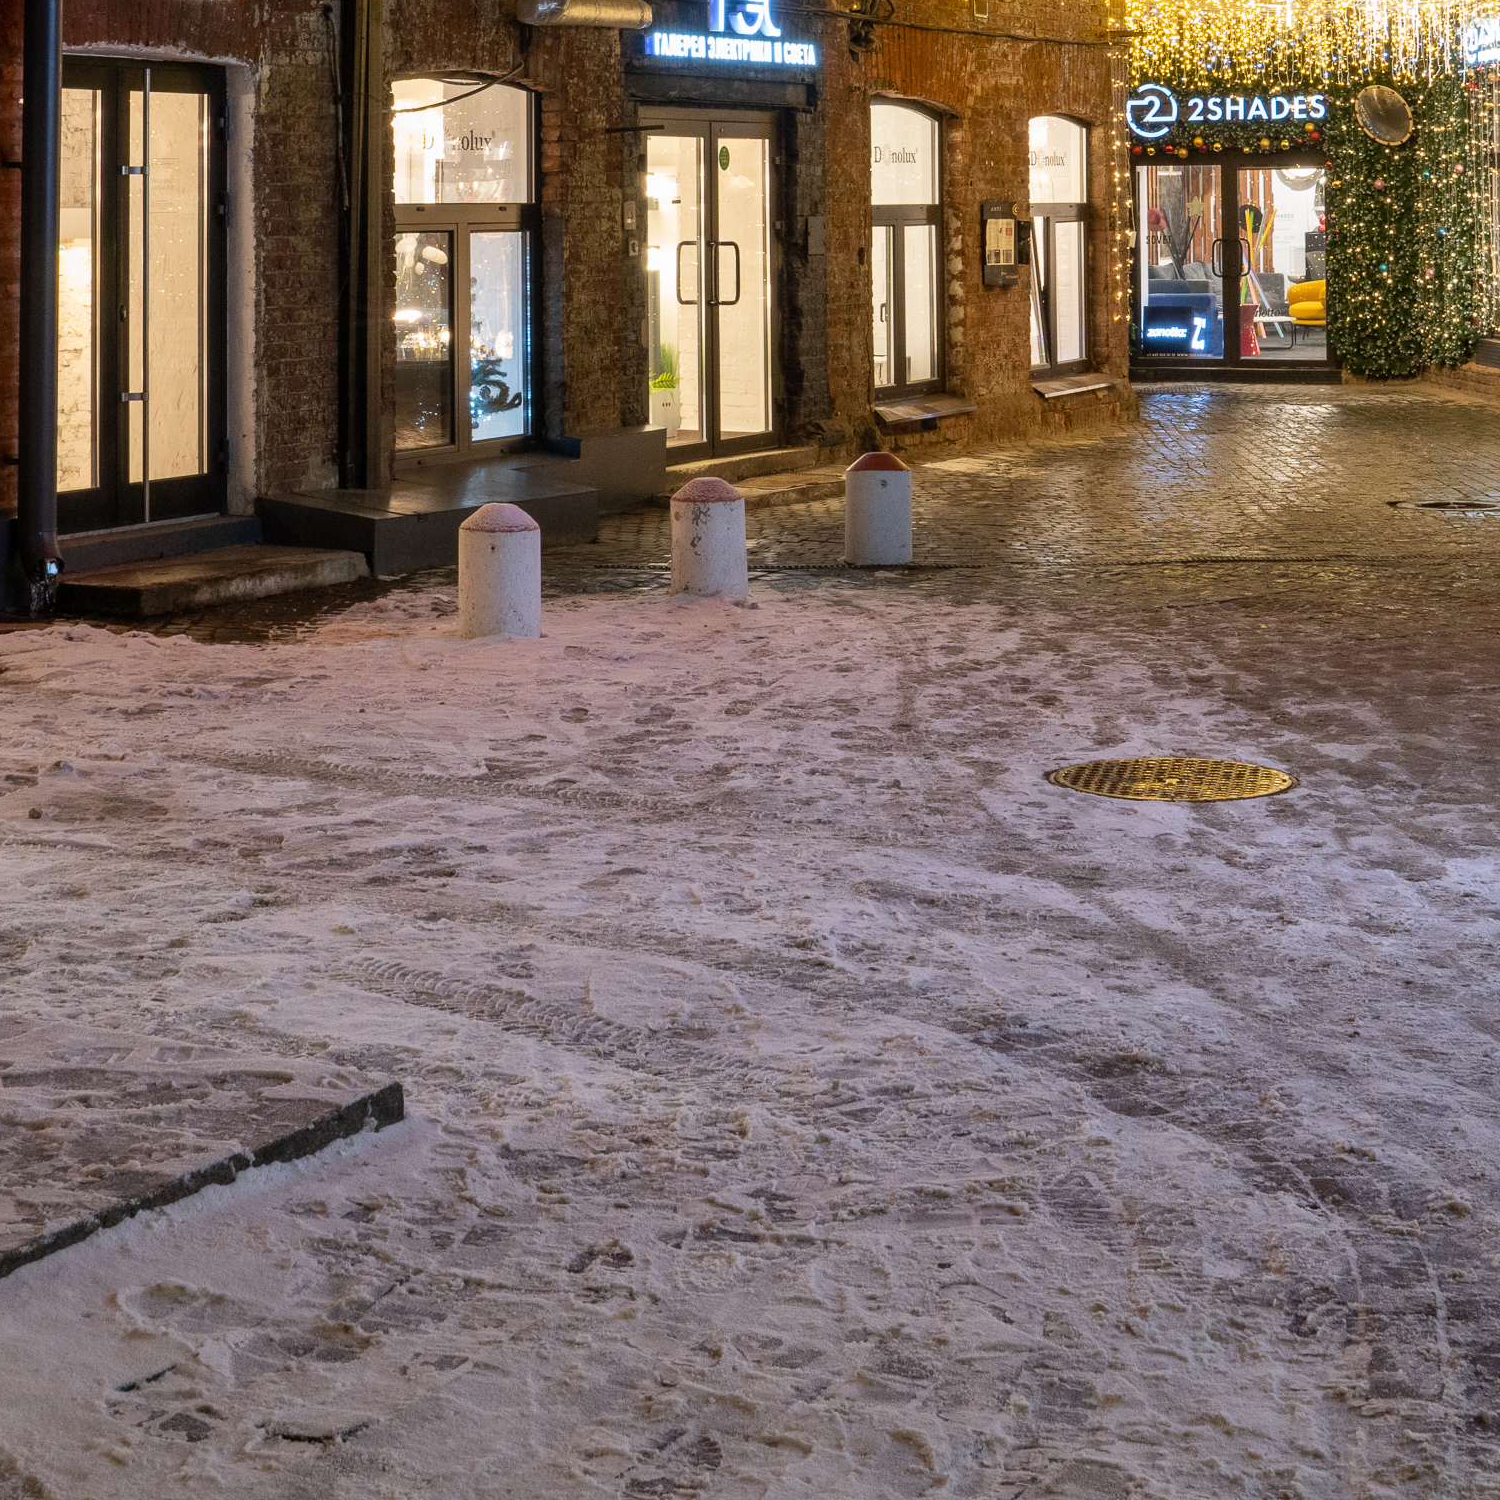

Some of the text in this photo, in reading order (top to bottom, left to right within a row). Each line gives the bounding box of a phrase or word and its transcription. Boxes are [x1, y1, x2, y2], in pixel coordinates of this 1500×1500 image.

[653, 31, 707, 59] ГАЛЕРЕЯ
[783, 42, 817, 66] СВЕТА
[1187, 94, 1327, 121] 2SHADES
